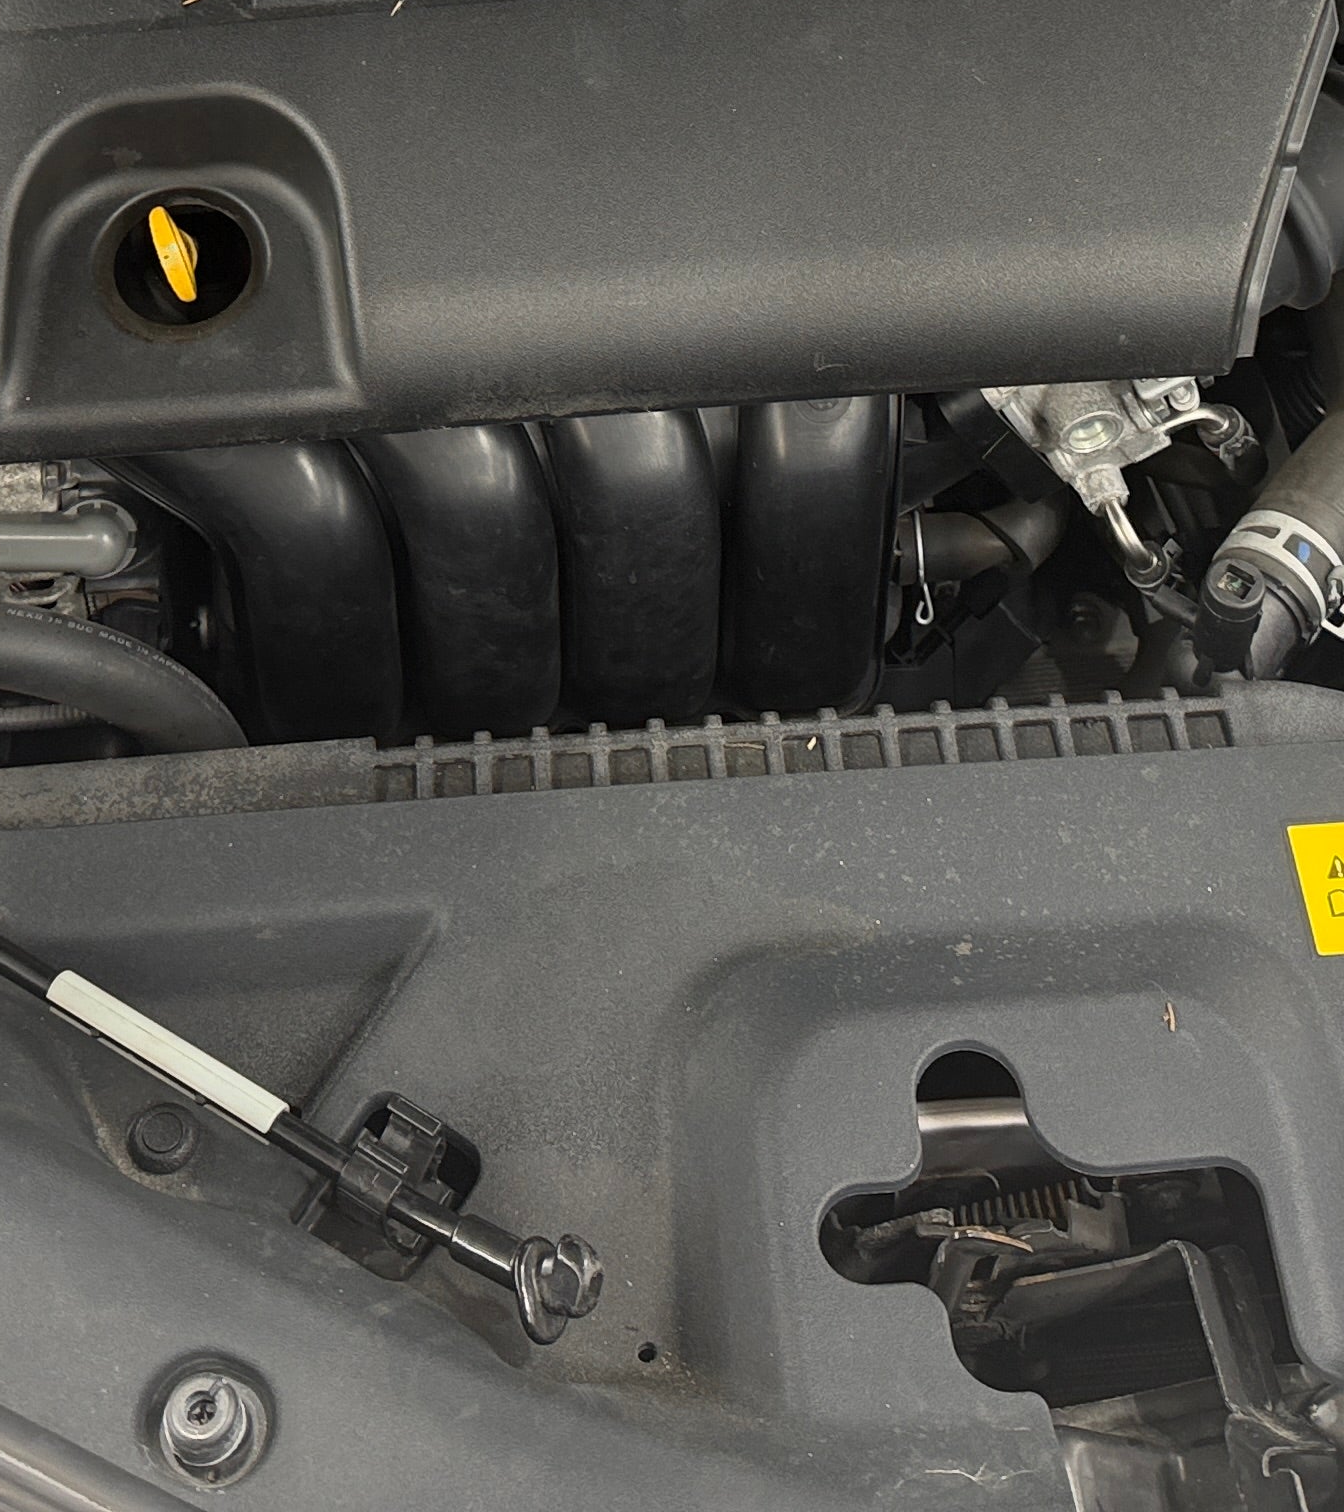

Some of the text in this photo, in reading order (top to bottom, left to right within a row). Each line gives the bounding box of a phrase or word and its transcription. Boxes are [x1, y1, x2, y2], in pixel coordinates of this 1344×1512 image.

[98, 631, 133, 649] MADE
[137, 645, 149, 656] IN
[152, 654, 186, 676] JAPAN
